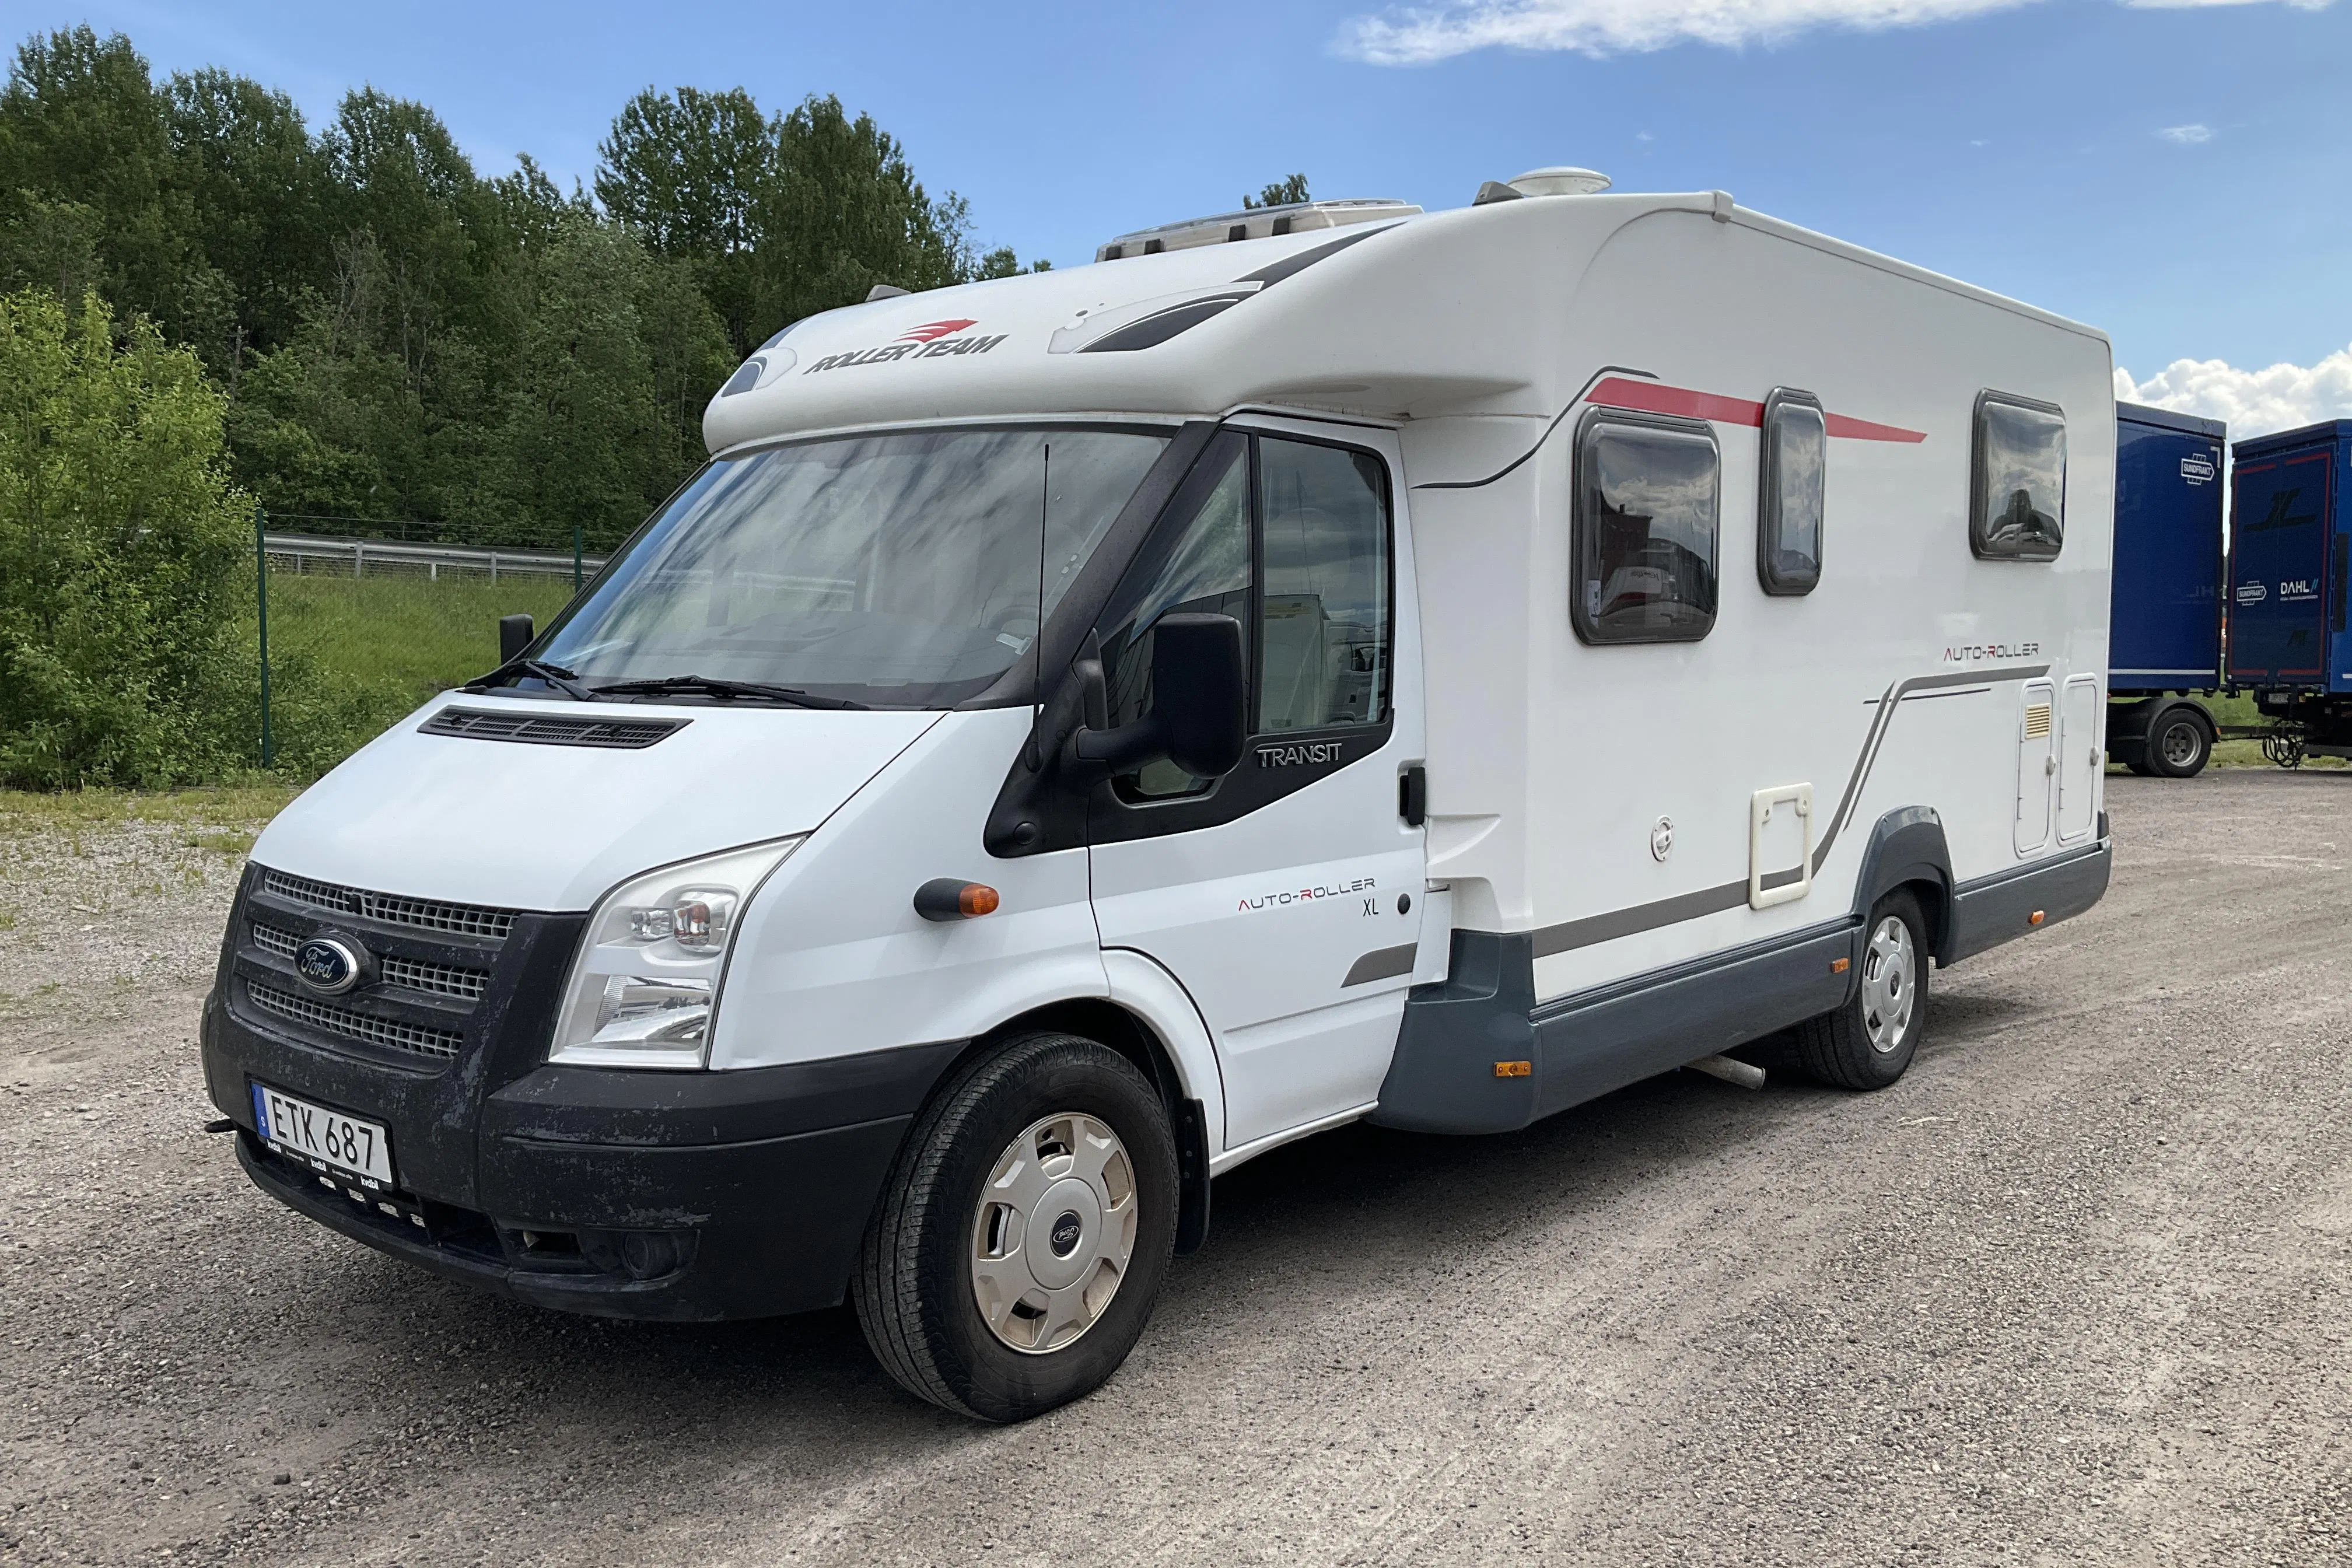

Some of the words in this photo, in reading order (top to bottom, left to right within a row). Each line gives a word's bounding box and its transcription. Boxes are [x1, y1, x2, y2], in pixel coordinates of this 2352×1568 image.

[802, 343, 919, 375] ROLLER
[911, 334, 1010, 359] TEAM
[2183, 463, 2211, 475] SUNDFRAKT
[2280, 580, 2310, 594] DAHL
[1944, 642, 2039, 662] AUTO-ROLLER
[1256, 743, 1342, 768] TRANSIT
[1238, 877, 1376, 912] AUTO-ROLLER
[1363, 898, 1379, 917] XL
[301, 946, 336, 979] Ford
[260, 1116, 265, 1127] S
[271, 1094, 318, 1152] ETK
[326, 1116, 372, 1170] 687
